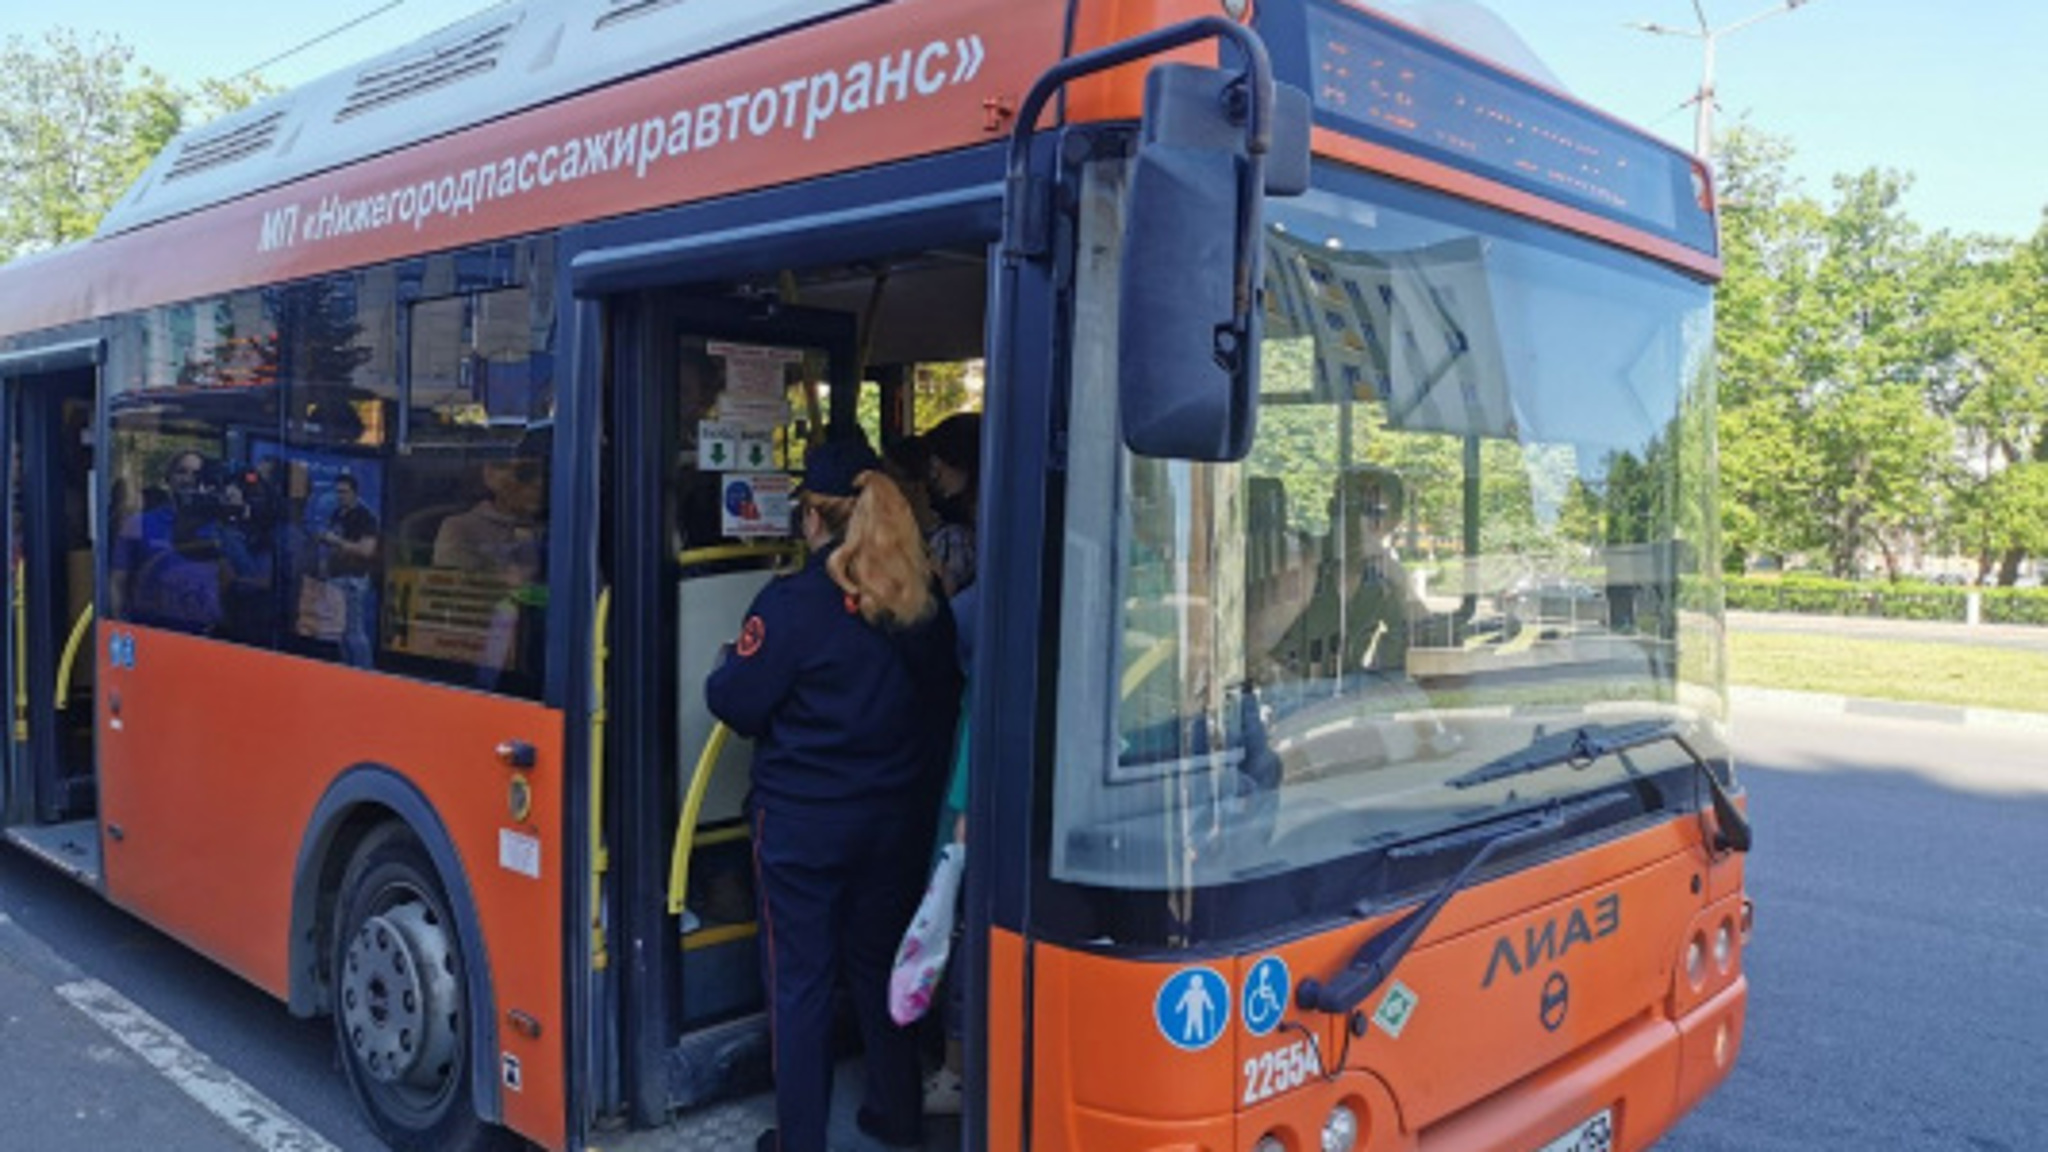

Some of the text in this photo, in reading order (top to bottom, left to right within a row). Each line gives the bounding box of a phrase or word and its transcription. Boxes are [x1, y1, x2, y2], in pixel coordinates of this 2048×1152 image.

[258, 34, 984, 251] МП «Нижегородпассажиравтотранс»
[1244, 1033, 1319, 1104] 22554
